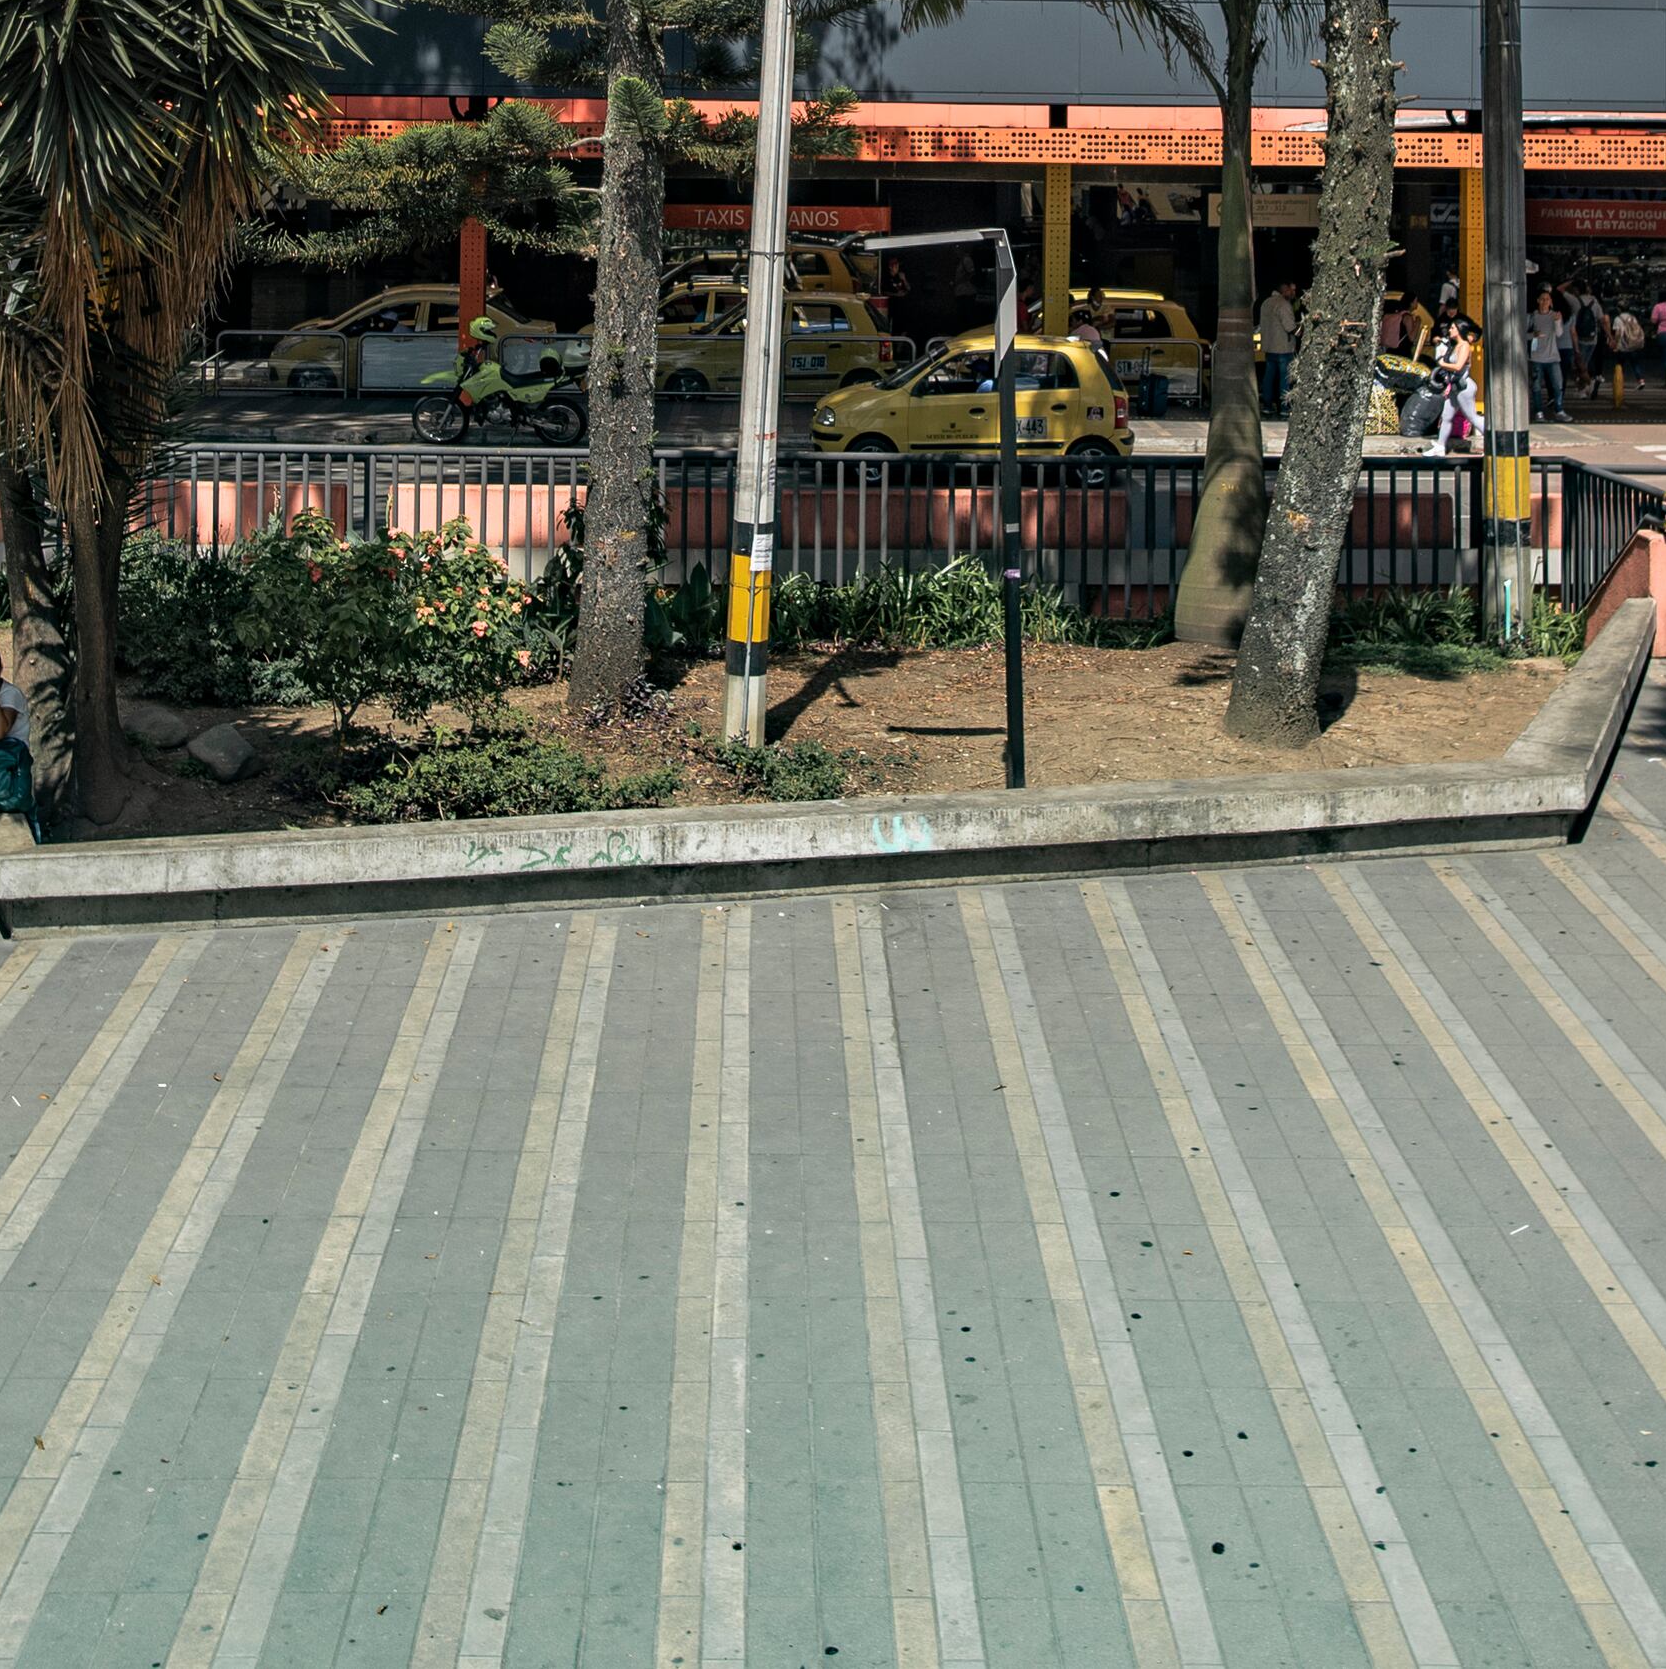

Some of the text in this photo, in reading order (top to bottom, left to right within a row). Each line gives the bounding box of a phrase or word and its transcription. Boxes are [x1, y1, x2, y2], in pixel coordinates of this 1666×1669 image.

[694, 209, 840, 228] TAXIS ANOS
[1541, 208, 1603, 219] FARMACIA
[1607, 209, 1616, 219] Y
[1576, 218, 1657, 231] LA ESTACIÓN
